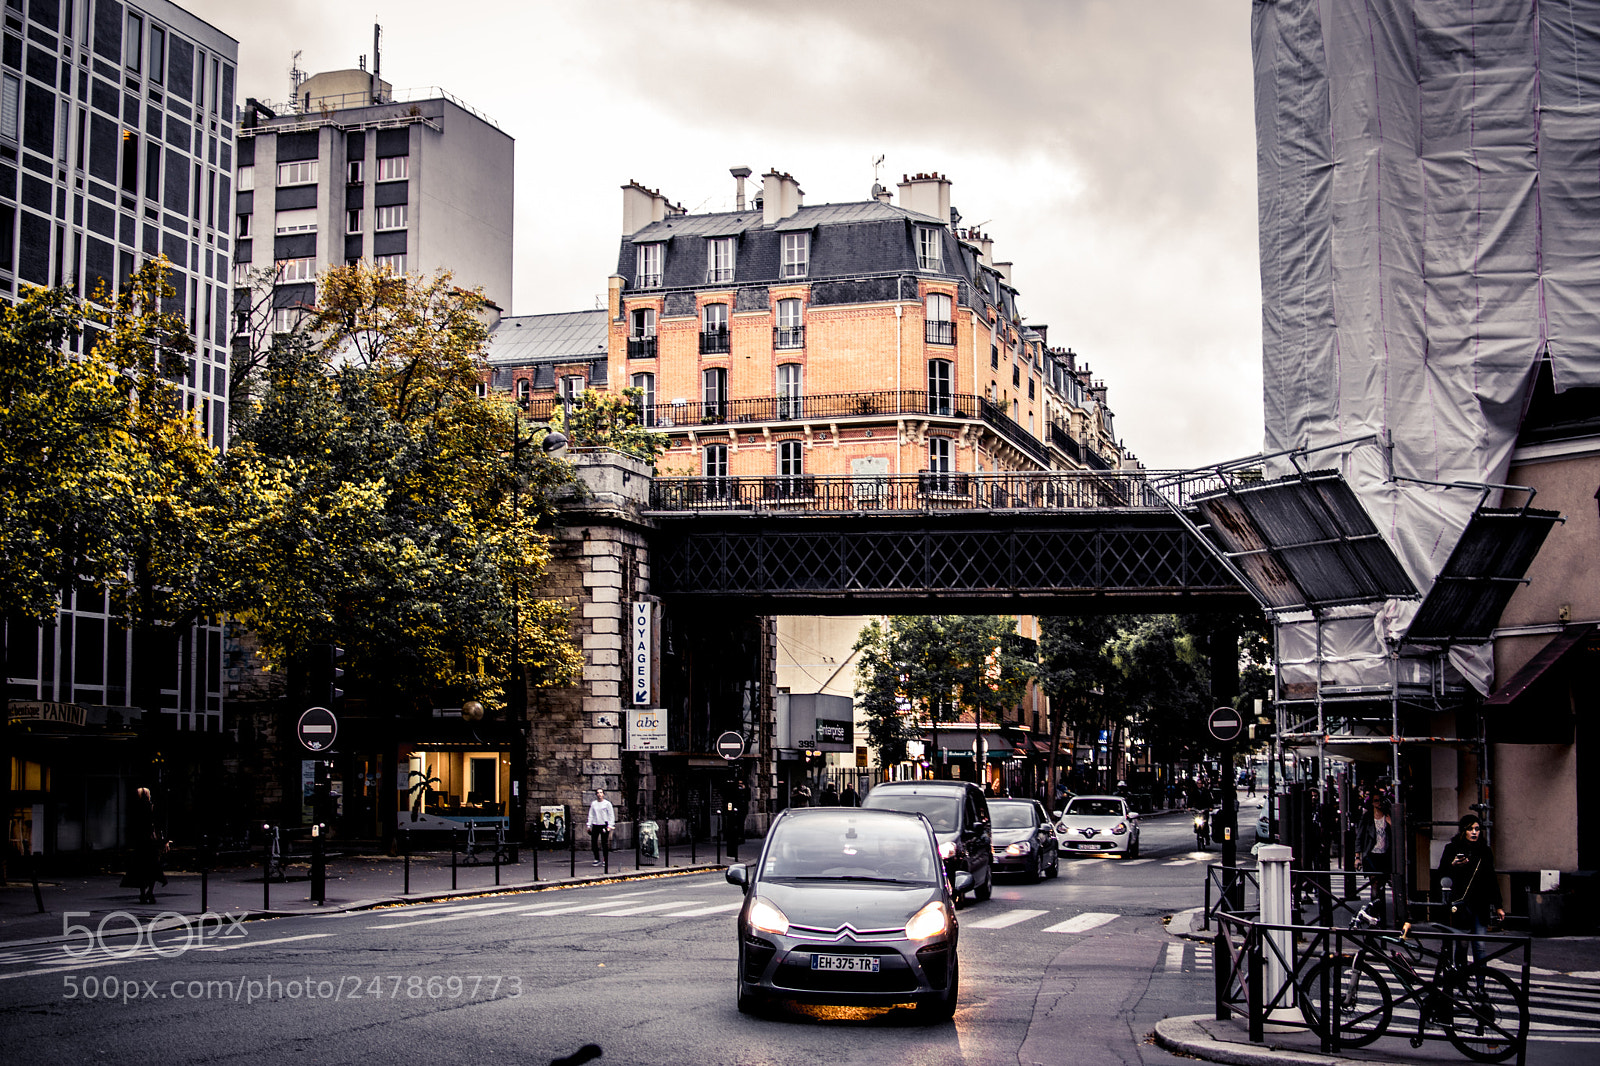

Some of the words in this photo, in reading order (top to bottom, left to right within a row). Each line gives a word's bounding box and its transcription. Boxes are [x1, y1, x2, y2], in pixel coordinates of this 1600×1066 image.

[637, 604, 646, 688] VOYAGES
[43, 703, 84, 726] PANINI
[636, 717, 659, 728] abc
[817, 724, 844, 739] enterprise
[798, 740, 815, 748] 399
[819, 957, 871, 970] EH-375-TR
